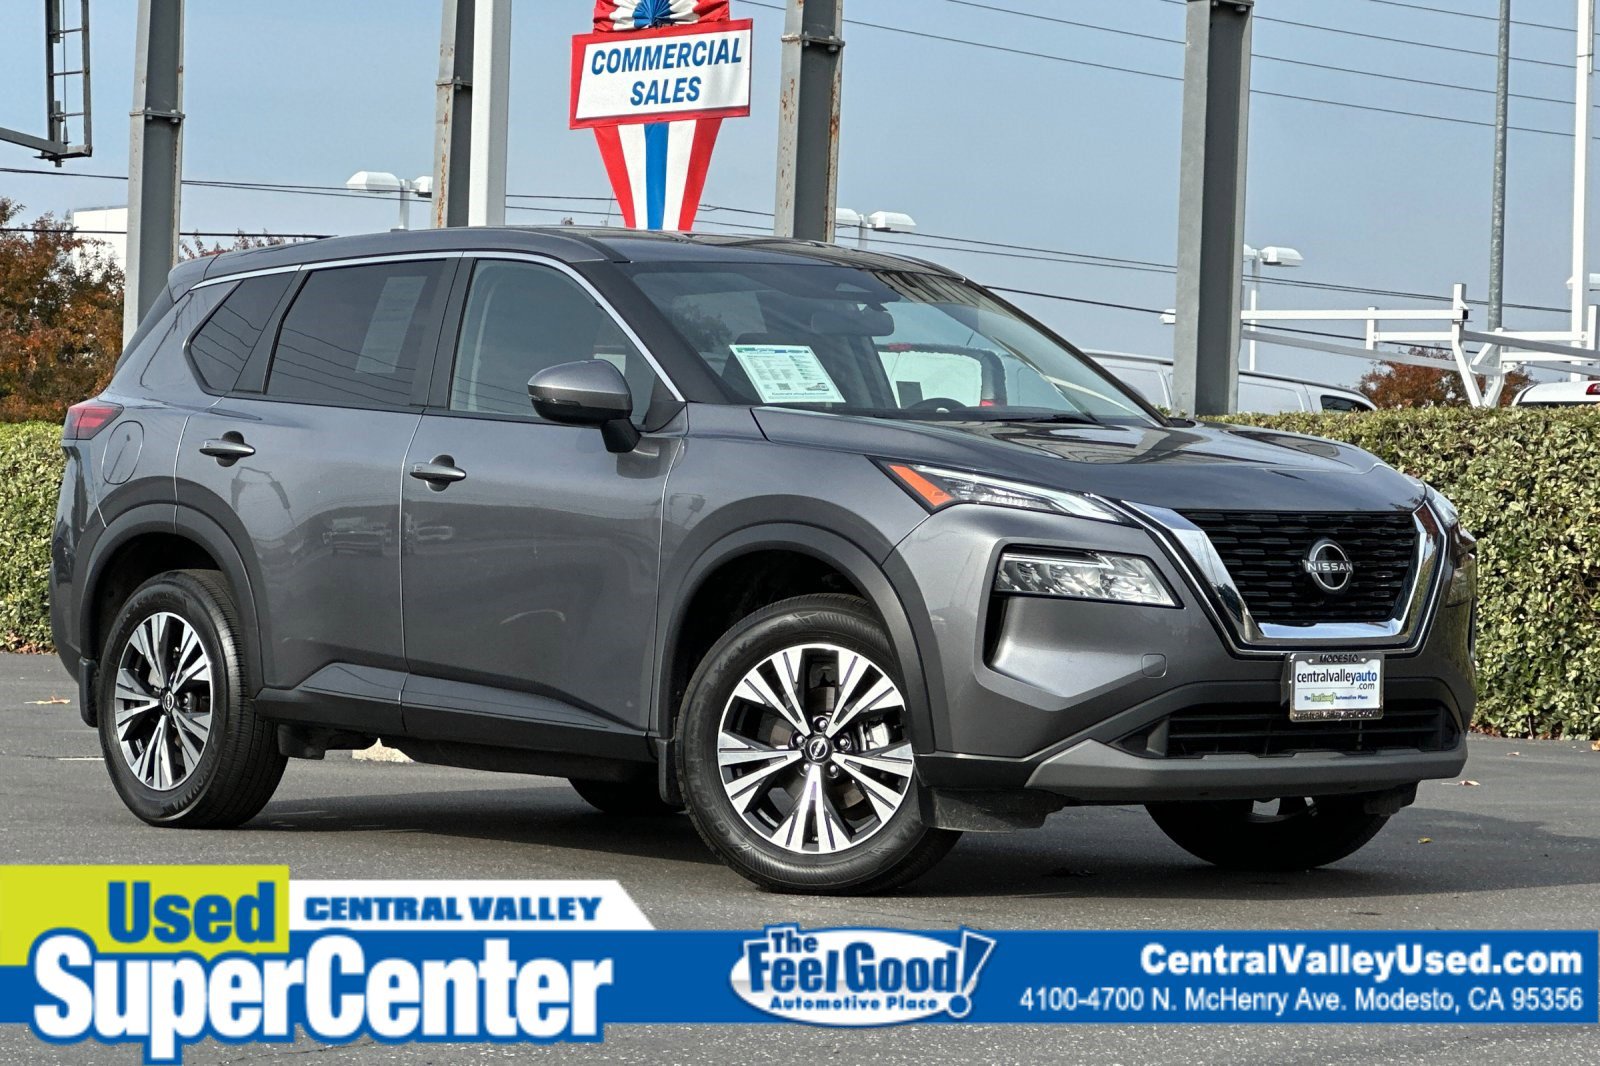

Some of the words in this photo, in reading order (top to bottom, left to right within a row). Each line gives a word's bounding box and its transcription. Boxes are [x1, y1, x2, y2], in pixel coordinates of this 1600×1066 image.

[591, 37, 742, 75] COMMERCIAL
[630, 76, 701, 106] SALES
[1307, 562, 1353, 572] NISSAN
[1320, 653, 1358, 663] MODESTO
[1296, 668, 1378, 686] centralvalleyauto
[1356, 682, 1375, 690] .com
